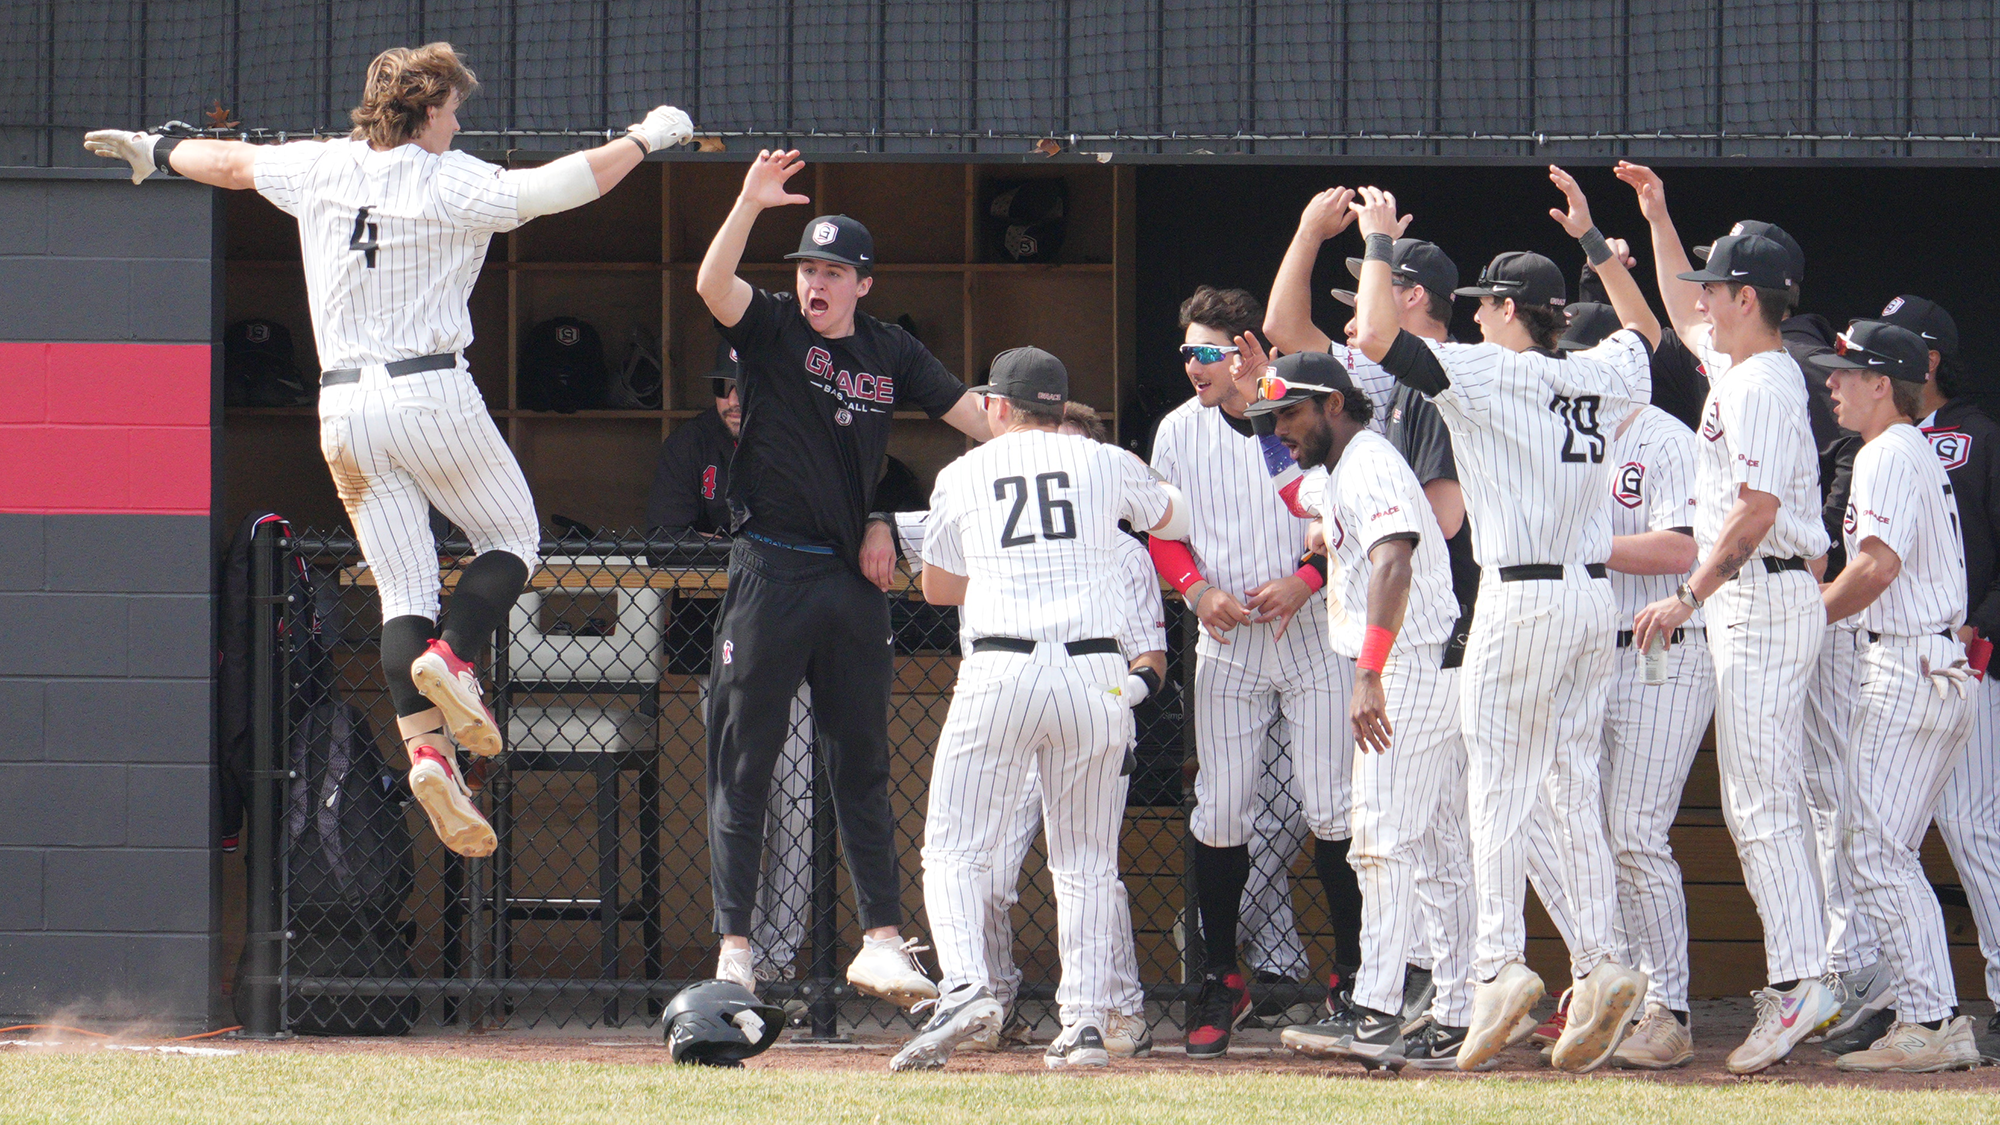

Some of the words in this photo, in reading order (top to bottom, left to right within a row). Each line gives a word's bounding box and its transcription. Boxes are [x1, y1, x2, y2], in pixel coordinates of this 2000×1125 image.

[349, 205, 379, 268] 4
[823, 384, 868, 413] BASALL
[1549, 395, 1606, 463] 29
[701, 464, 718, 500] 4
[1622, 467, 1642, 497] G
[993, 471, 1077, 549] 26
